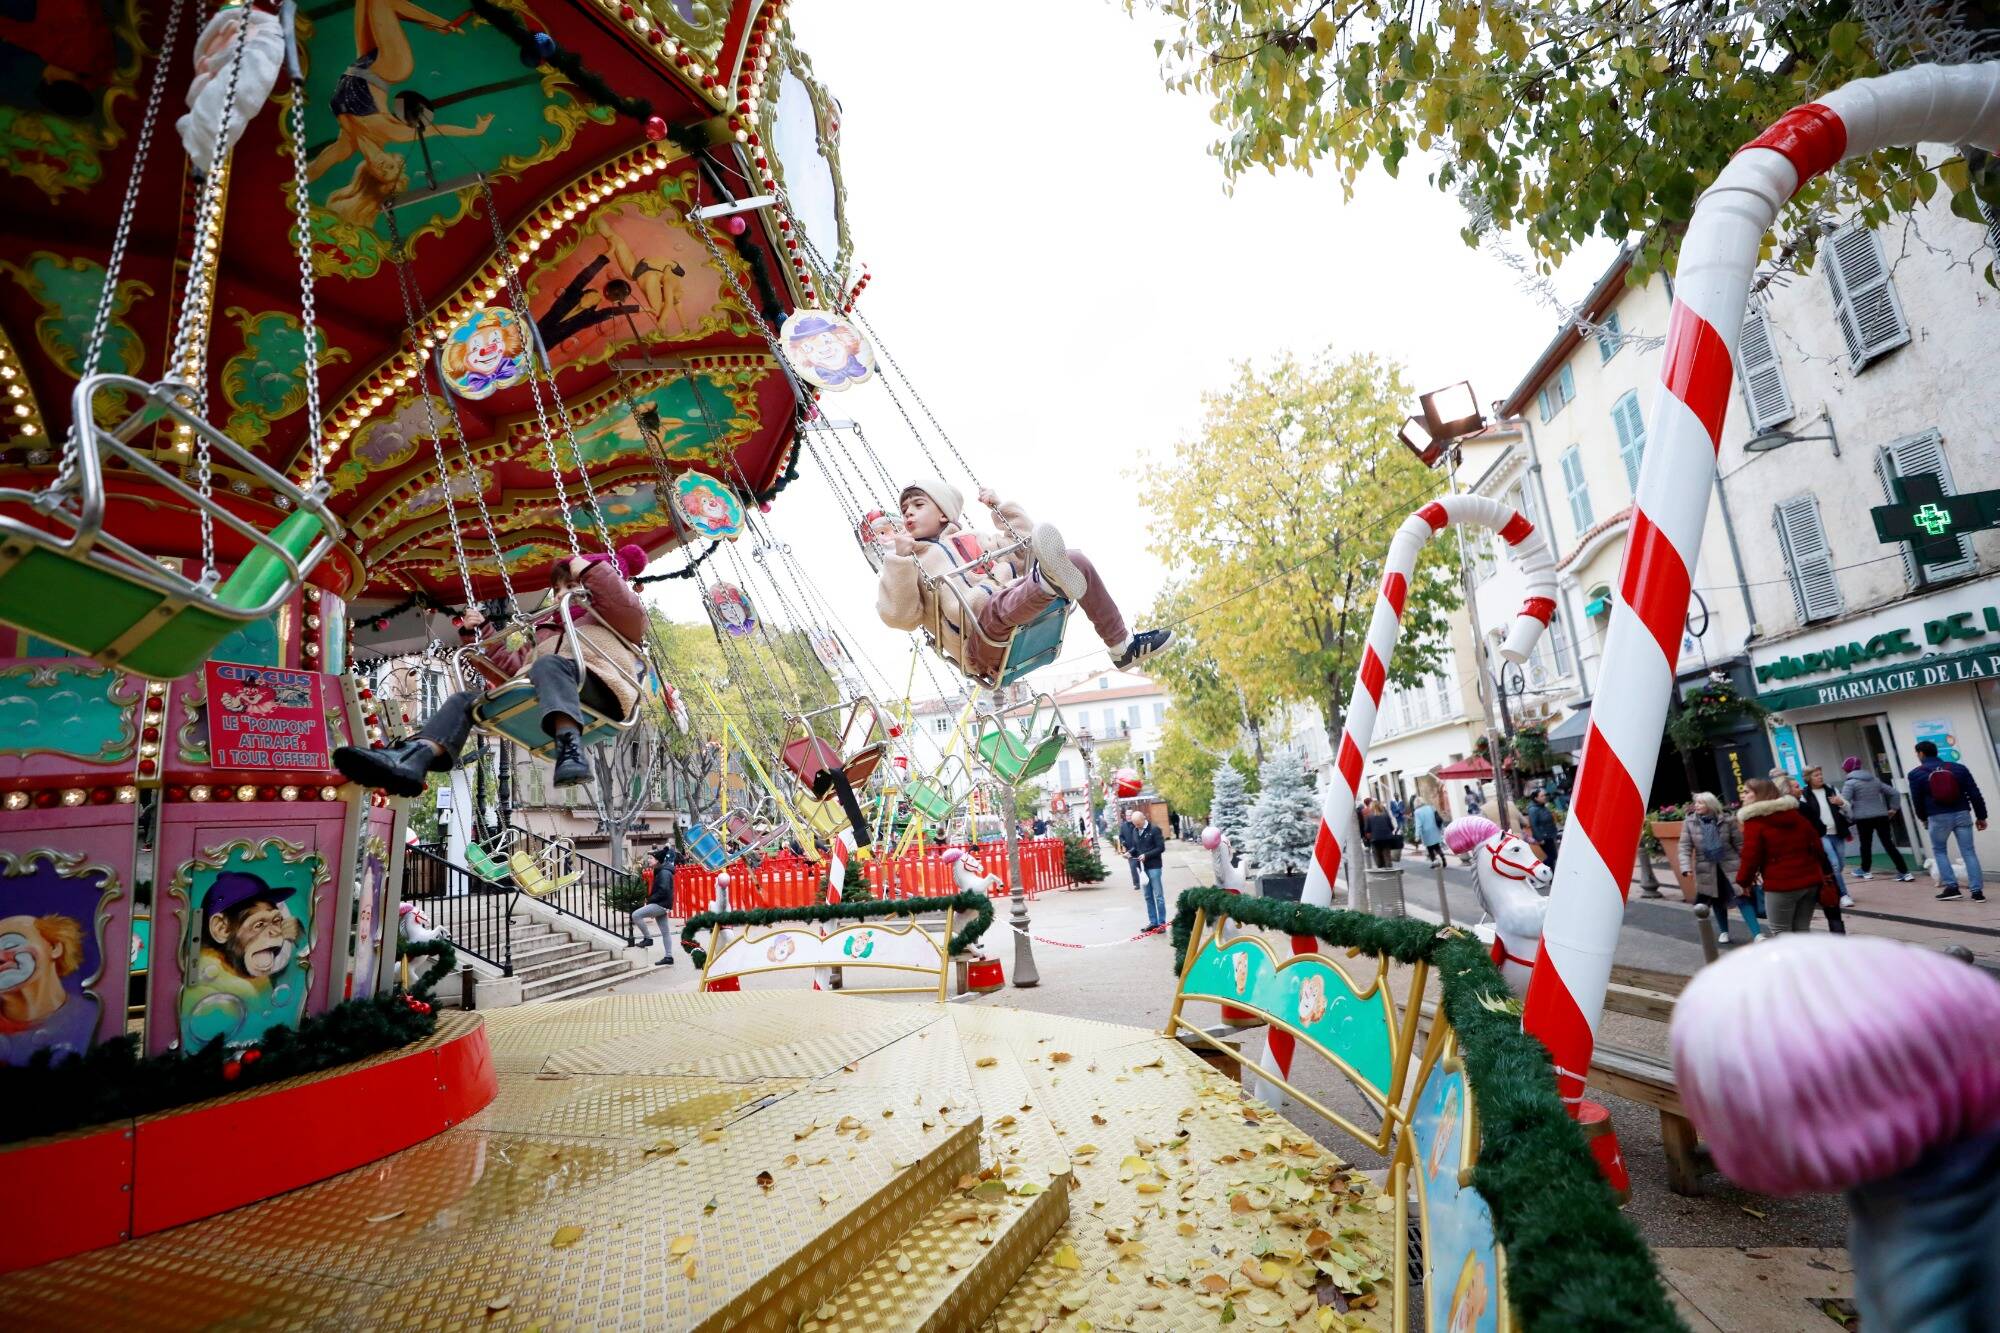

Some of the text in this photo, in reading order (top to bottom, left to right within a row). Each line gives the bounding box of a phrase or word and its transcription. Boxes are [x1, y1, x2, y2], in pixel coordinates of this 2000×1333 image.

[1923, 611, 1986, 646] DE
[216, 665, 312, 687] CIRCUS
[1817, 670, 1919, 704] PHARMACIE
[1923, 664, 1951, 685] DE
[1955, 659, 1985, 680] LA
[221, 715, 239, 731] LE
[239, 733, 299, 751] ATTRAPE
[230, 749, 269, 766] TOUR
[272, 751, 319, 767] OFFERT
